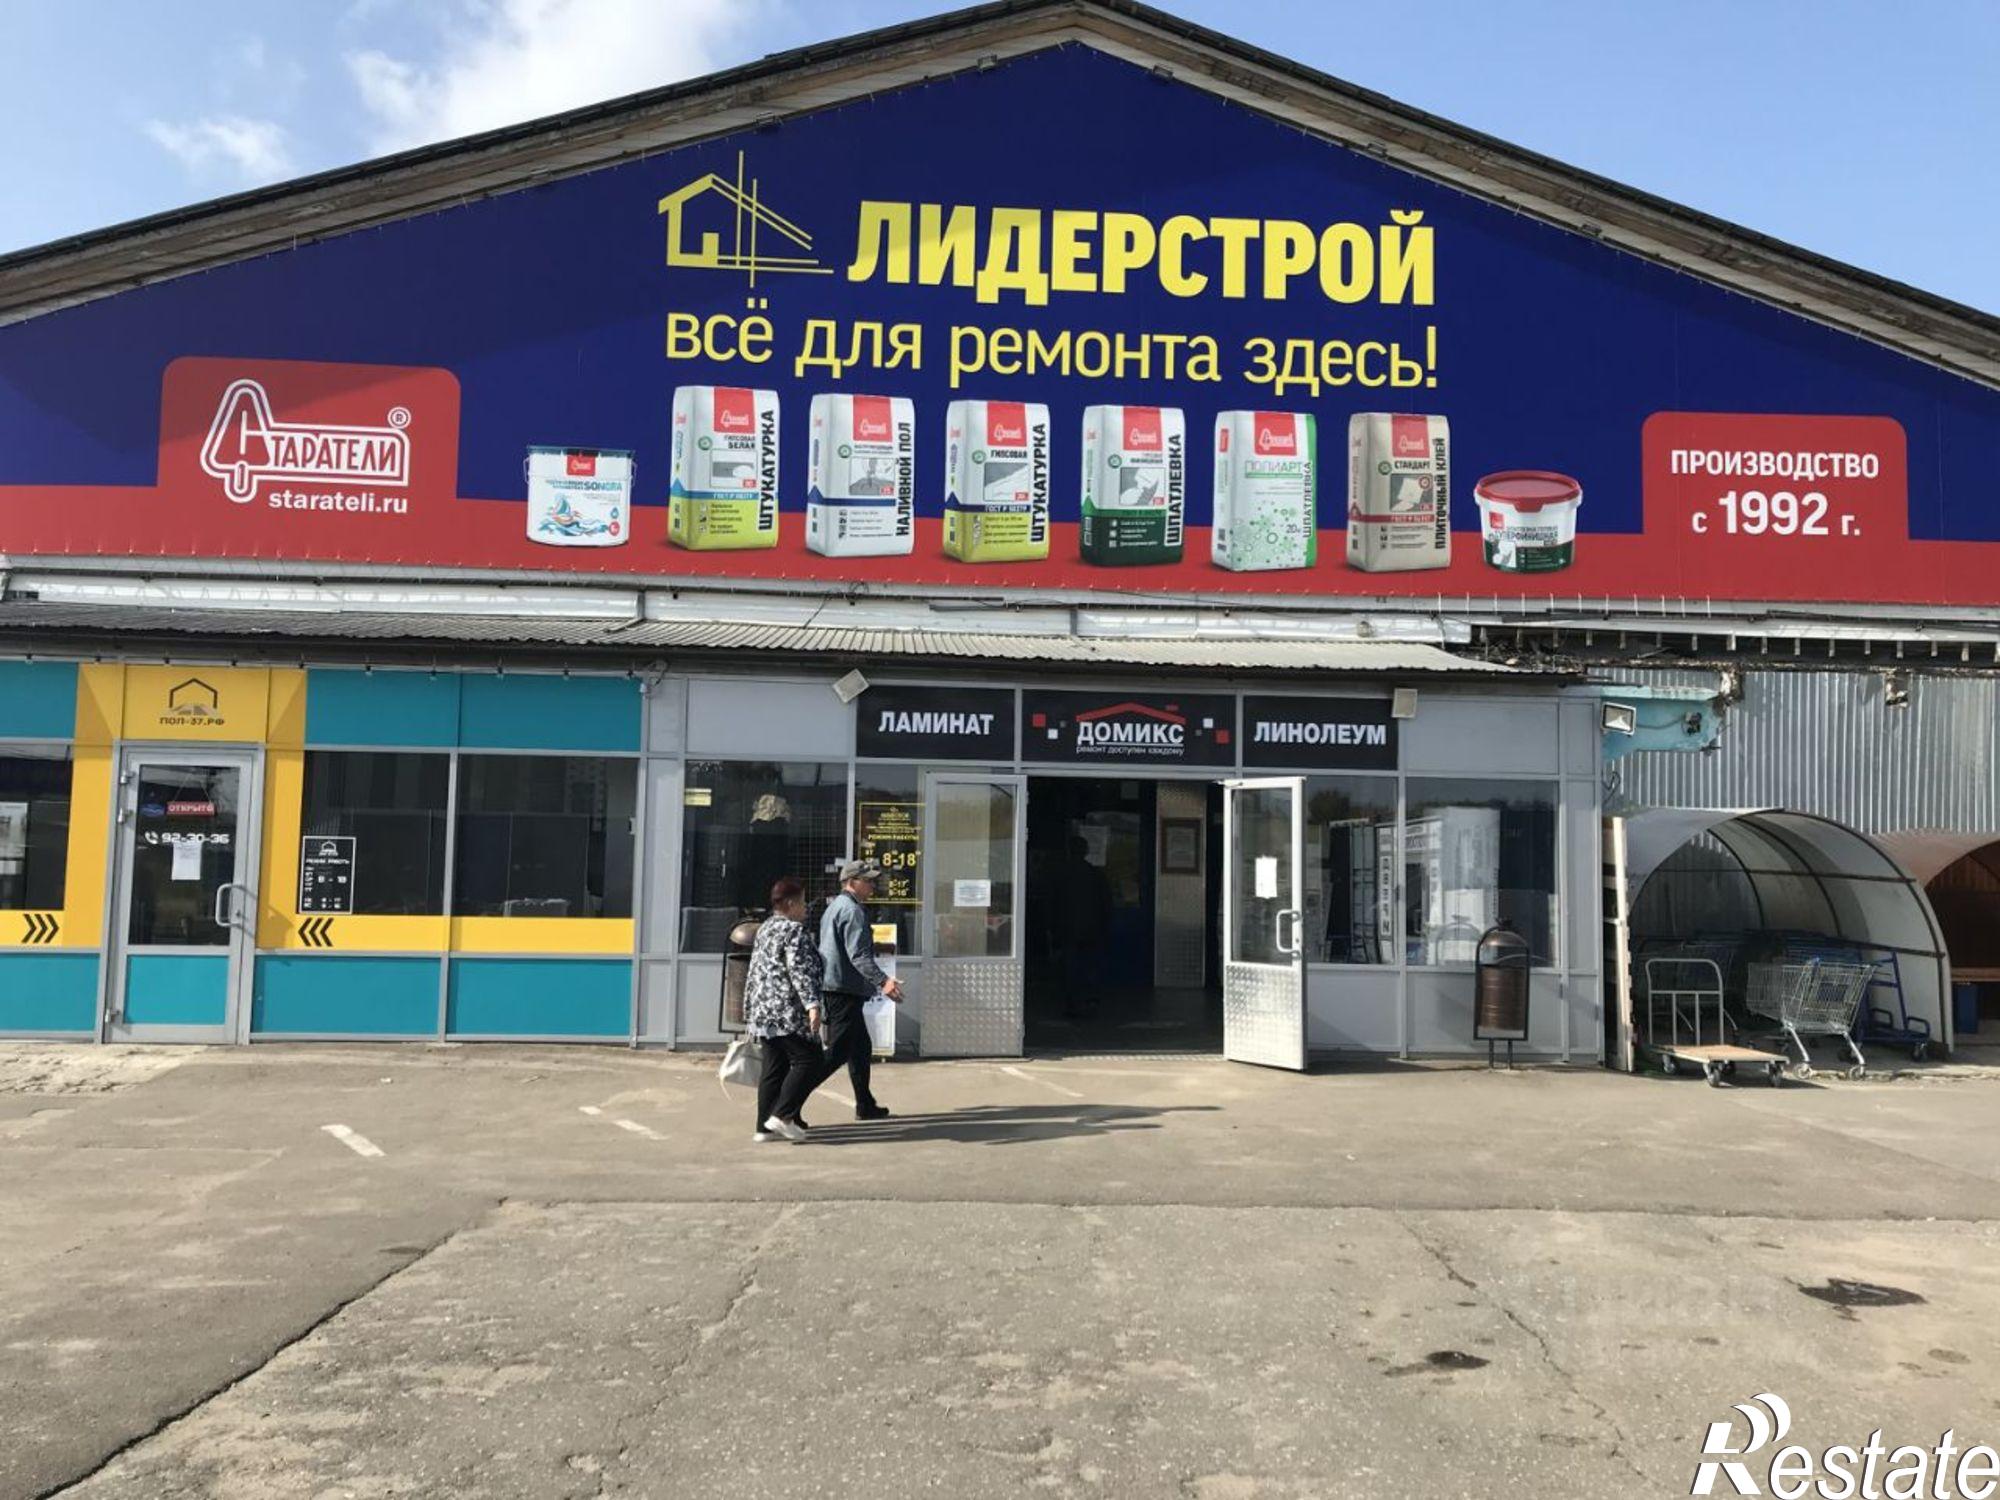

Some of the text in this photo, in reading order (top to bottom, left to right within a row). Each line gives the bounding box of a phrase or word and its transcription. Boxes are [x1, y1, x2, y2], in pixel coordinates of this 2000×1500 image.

[847, 200, 1436, 306] ЛИДЕРСТРОЙ
[665, 298, 1438, 397] всё для ремонта здесь!
[758, 410, 776, 531] ШТУКАТУРКА
[1432, 438, 1446, 471] КЛЕЙ
[1671, 449, 1880, 482] ПРОИЗВОДСТВО
[895, 422, 912, 536] НАЛИВНОЙ ПОЛ
[1030, 423, 1047, 543] ШТУКАТУРКА
[1166, 434, 1182, 544] ШПАТЛЕВКА
[268, 489, 408, 514] starateli.ru
[1691, 490, 1861, 536] с 1992 г.
[878, 710, 994, 736] ЛАМИНАТ
[1077, 721, 1184, 746] ДОМИКС
[1253, 720, 1387, 746] ЛИНОЛЕУМ
[168, 804, 215, 813] ОТКРЫТО
